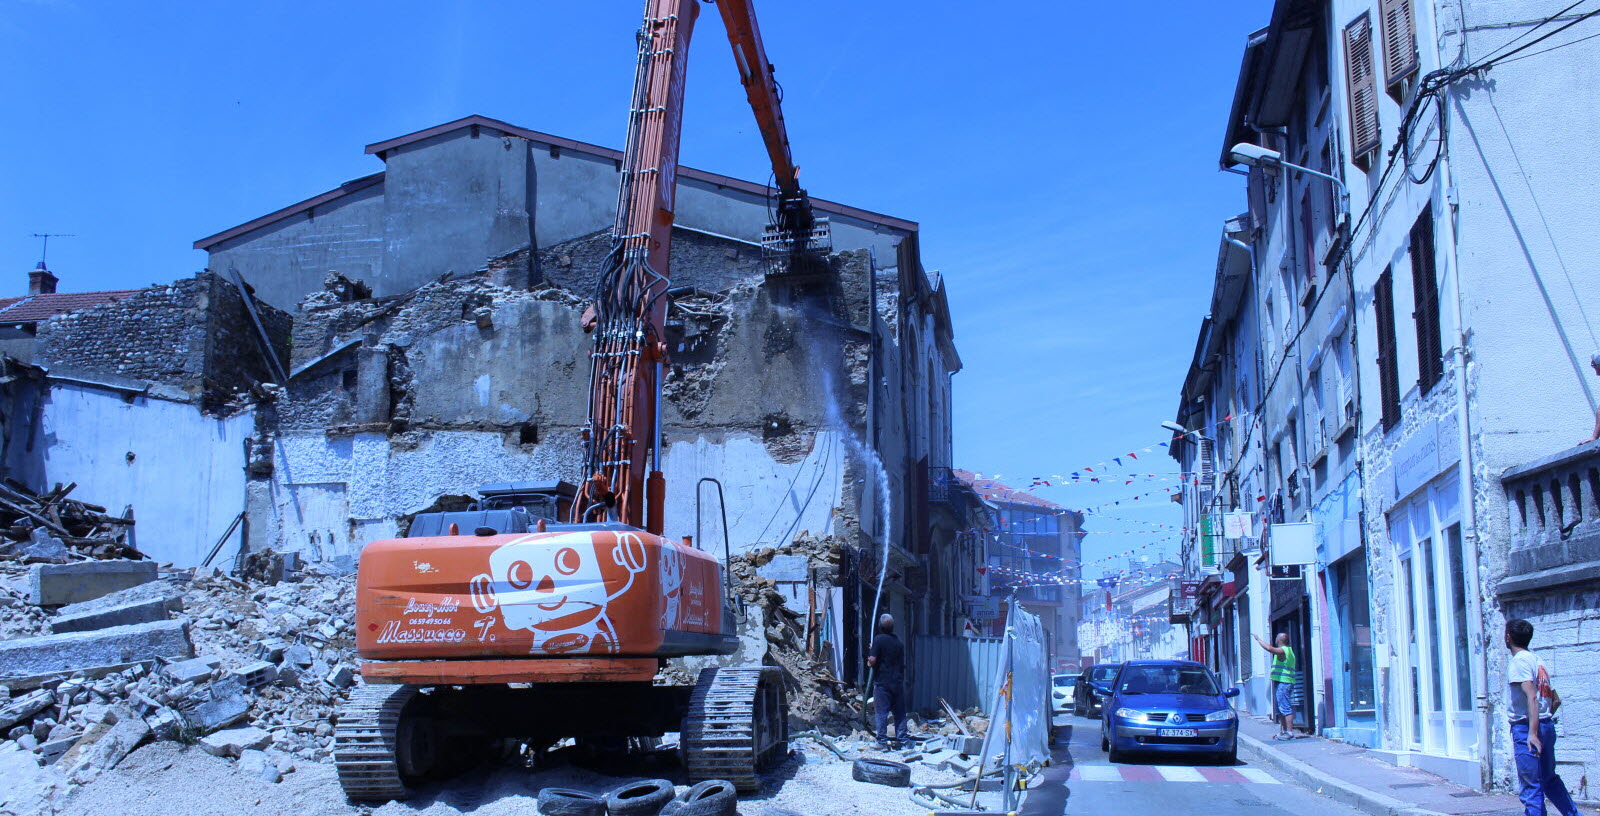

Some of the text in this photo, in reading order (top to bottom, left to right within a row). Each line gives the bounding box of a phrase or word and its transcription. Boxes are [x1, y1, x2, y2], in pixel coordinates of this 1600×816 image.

[404, 597, 460, 617] Louez-Moi
[377, 616, 496, 644] Massucco T.
